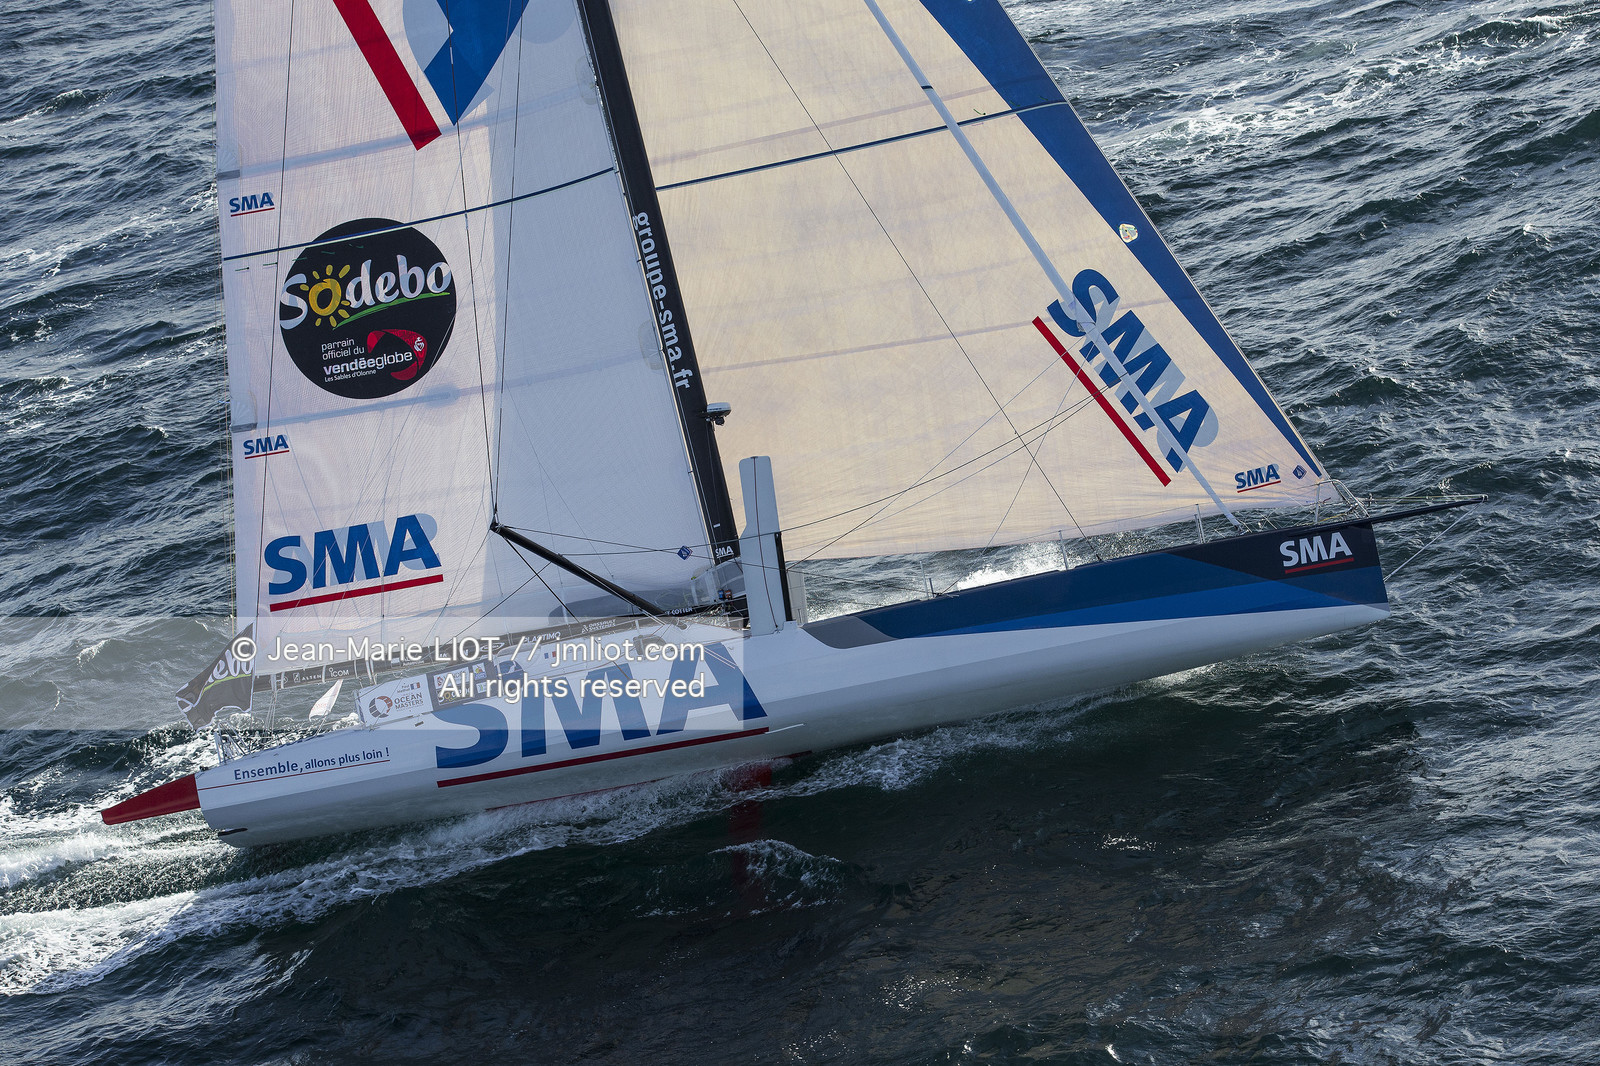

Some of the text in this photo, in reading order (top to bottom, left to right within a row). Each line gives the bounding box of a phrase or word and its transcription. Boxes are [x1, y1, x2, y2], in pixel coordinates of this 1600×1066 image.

[229, 192, 275, 214] SMA
[279, 254, 452, 330] Sodebo
[632, 211, 691, 390] groupe-sma.fr
[321, 337, 355, 352] parrain
[322, 345, 365, 360] officiel du
[334, 373, 351, 381] Sables
[351, 369, 377, 378] d'Olonne
[1046, 268, 1216, 474] SMA
[243, 434, 289, 456] SMA
[1234, 464, 1281, 489] SMA
[263, 513, 442, 596] SMA
[714, 545, 734, 557] SMA
[1280, 531, 1353, 567] SMA
[393, 692, 423, 704] OCEAN
[395, 700, 424, 710] MASTERS
[435, 641, 768, 769] SMA
[234, 747, 390, 781] Ensemble, allons plus loin !
